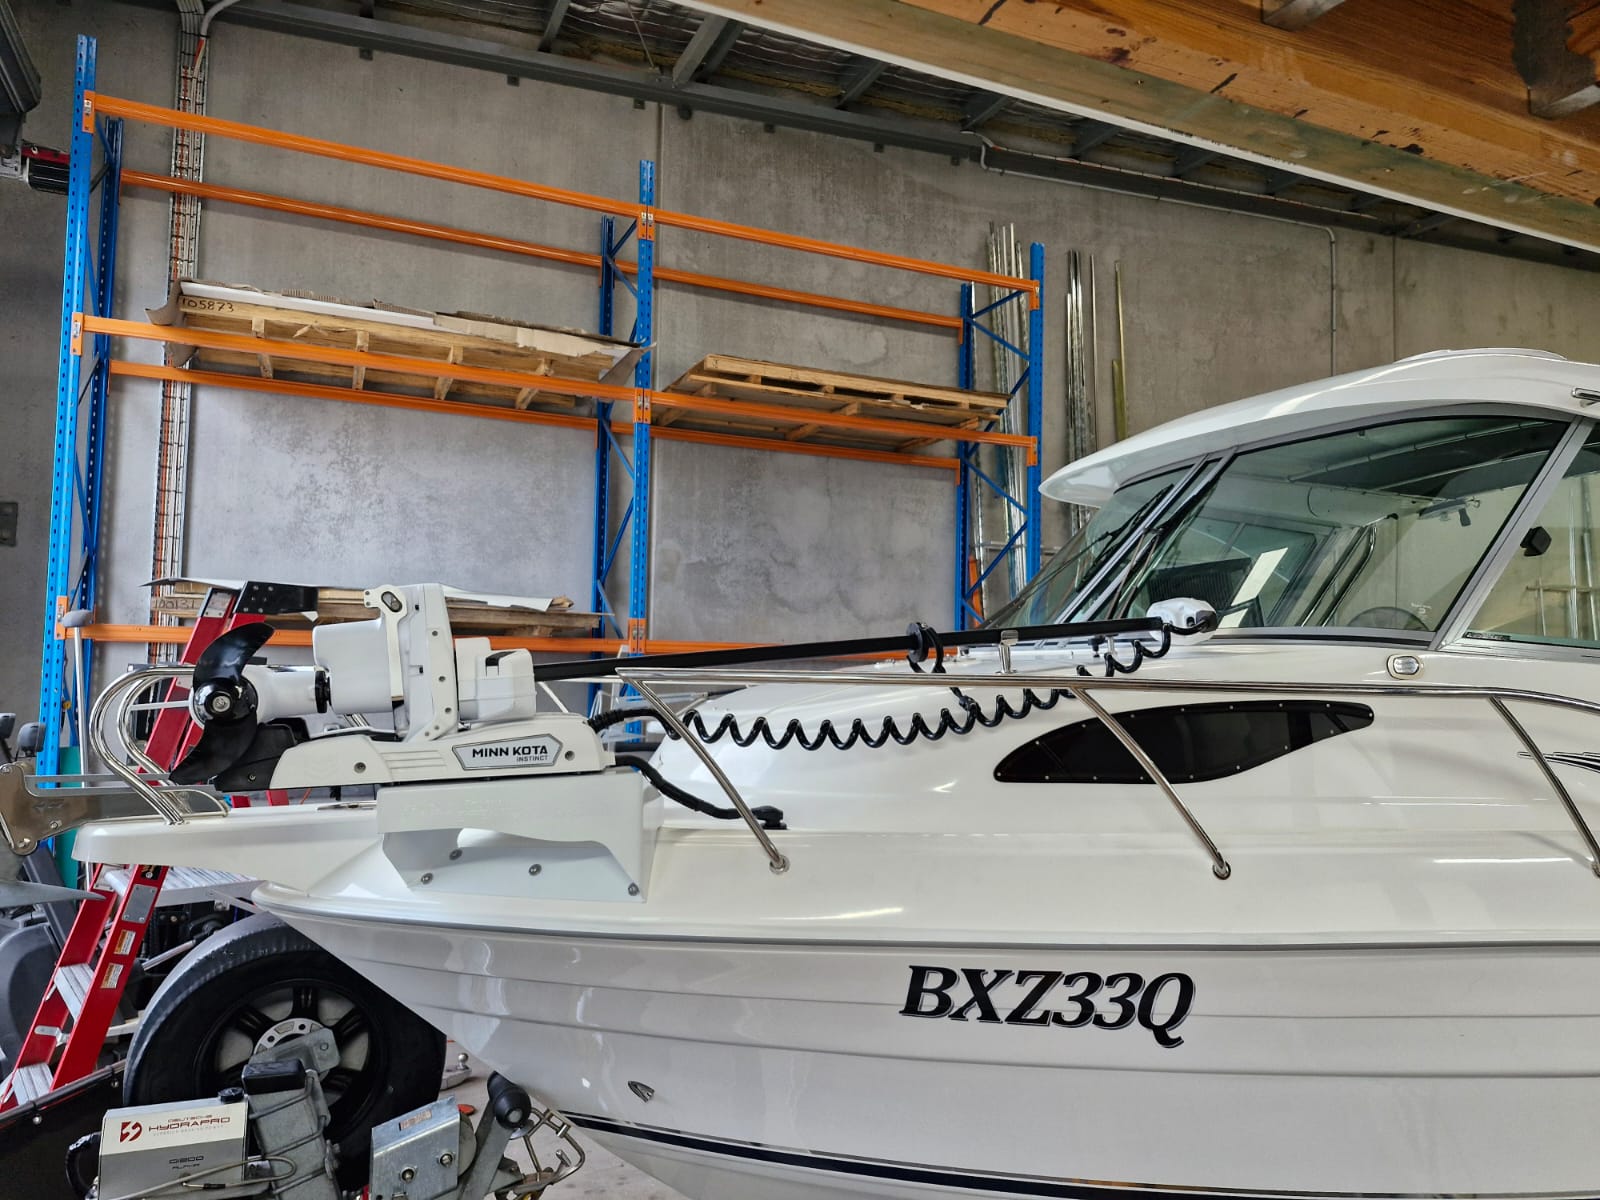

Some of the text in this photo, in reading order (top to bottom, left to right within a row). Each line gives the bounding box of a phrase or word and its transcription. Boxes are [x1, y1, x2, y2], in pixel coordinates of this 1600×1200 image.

[182, 298, 234, 313] 105873
[472, 745, 548, 758] MINN KOTA
[899, 965, 1196, 1048] BXZ33Q
[148, 1116, 231, 1133] HYDRAPRO
